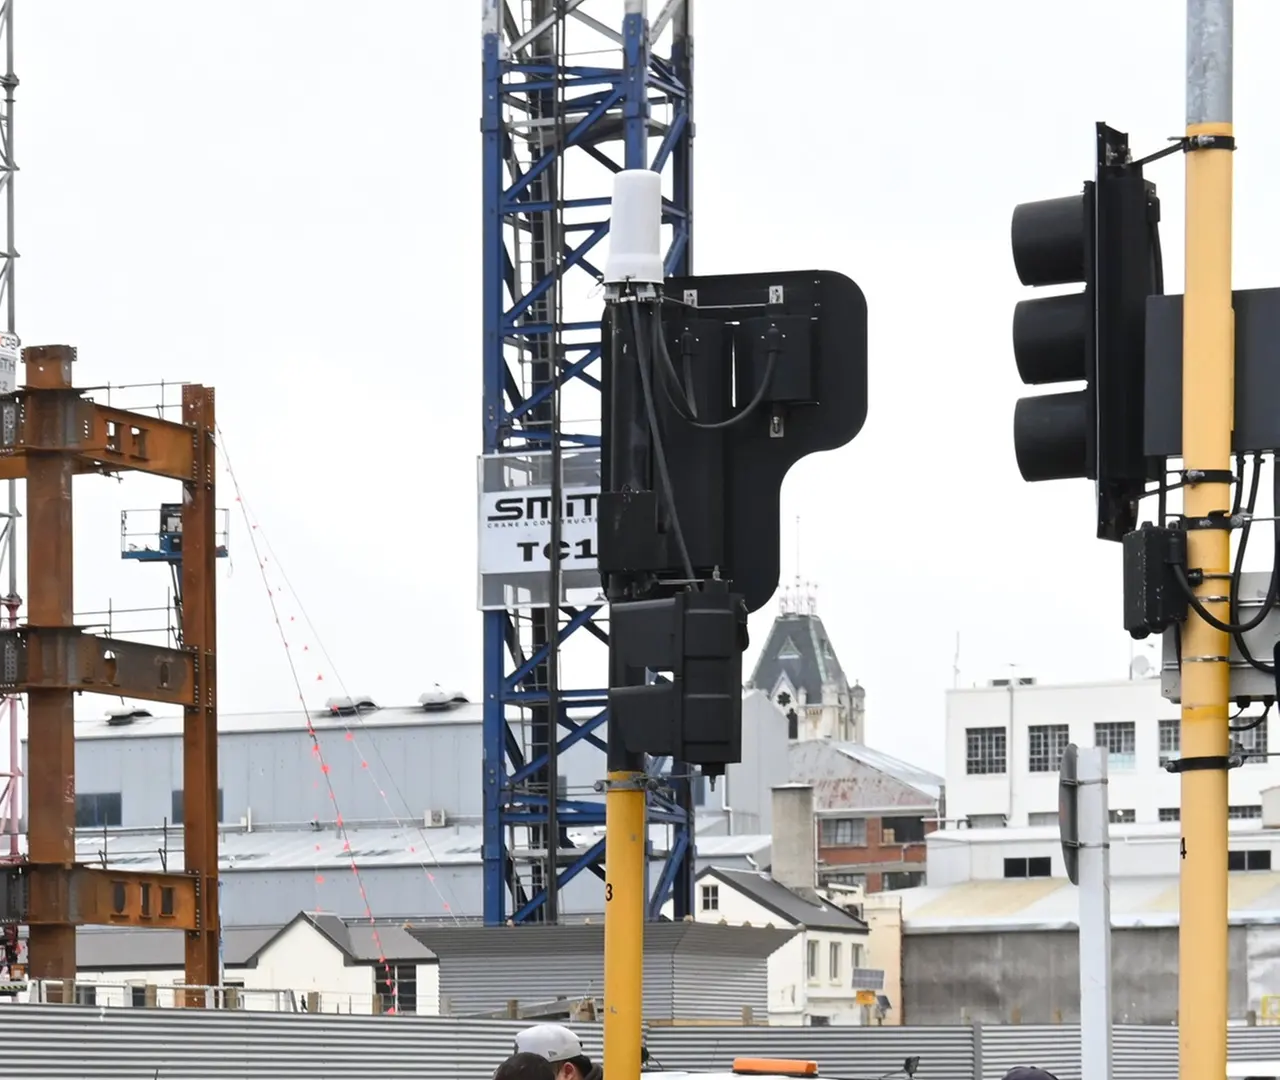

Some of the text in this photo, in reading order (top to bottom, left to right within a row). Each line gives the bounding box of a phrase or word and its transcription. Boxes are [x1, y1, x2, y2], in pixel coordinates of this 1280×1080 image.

[487, 494, 599, 521] SMIT
[487, 521, 519, 529] CRANE
[516, 538, 599, 562] TC1
